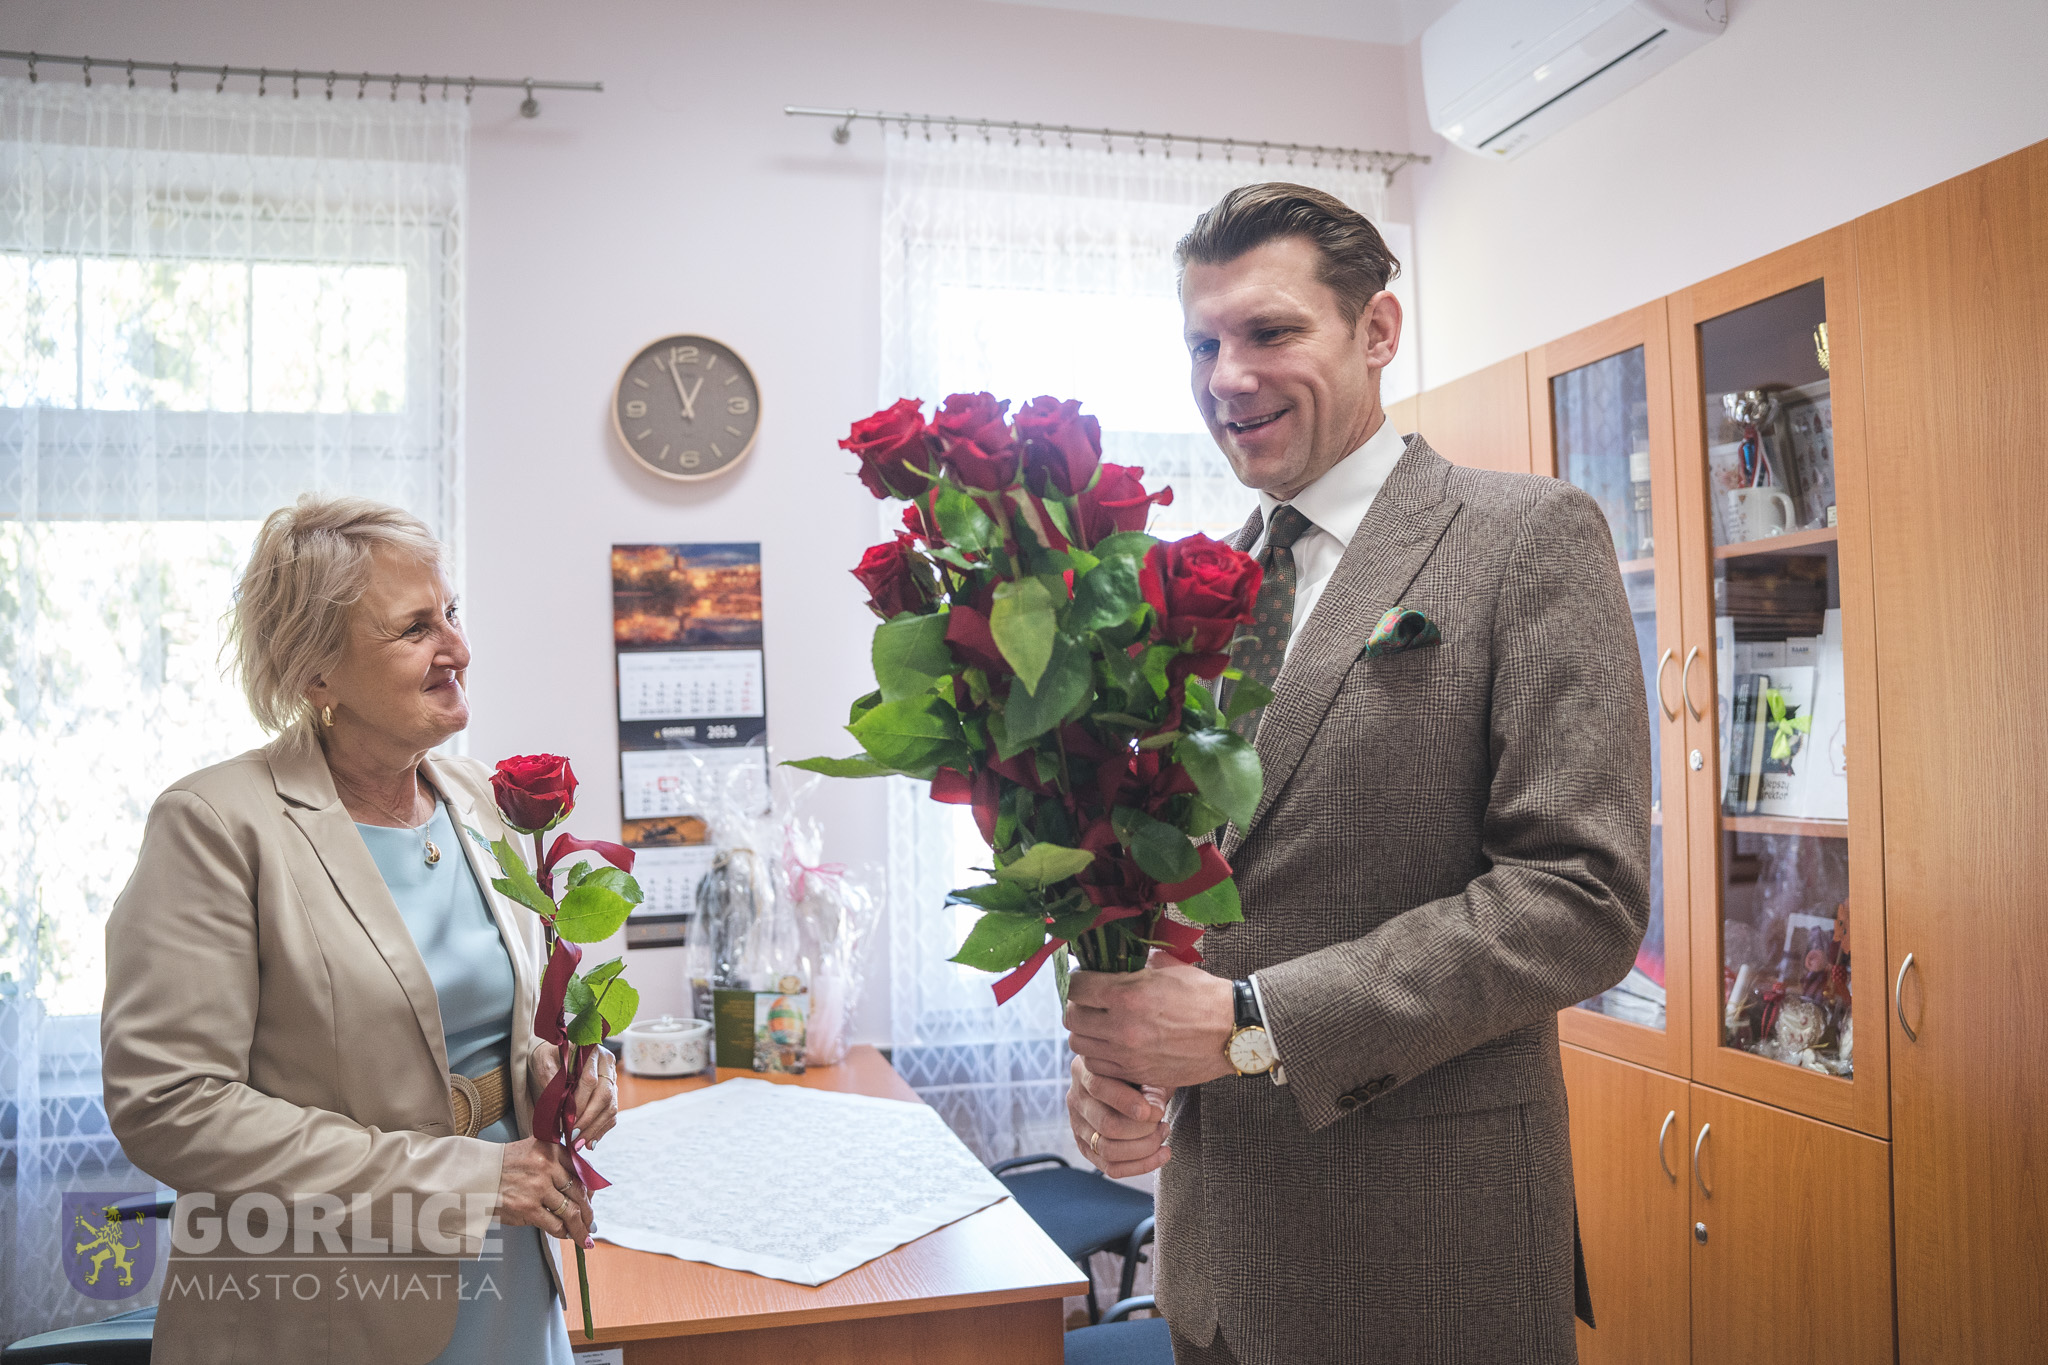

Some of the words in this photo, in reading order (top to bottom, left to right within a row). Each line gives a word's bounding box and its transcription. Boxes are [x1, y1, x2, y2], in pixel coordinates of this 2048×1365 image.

[671, 345, 699, 364] 12
[626, 399, 647, 418] 9
[727, 396, 750, 415] 3
[679, 449, 700, 468] 6
[707, 724, 738, 740] 2026
